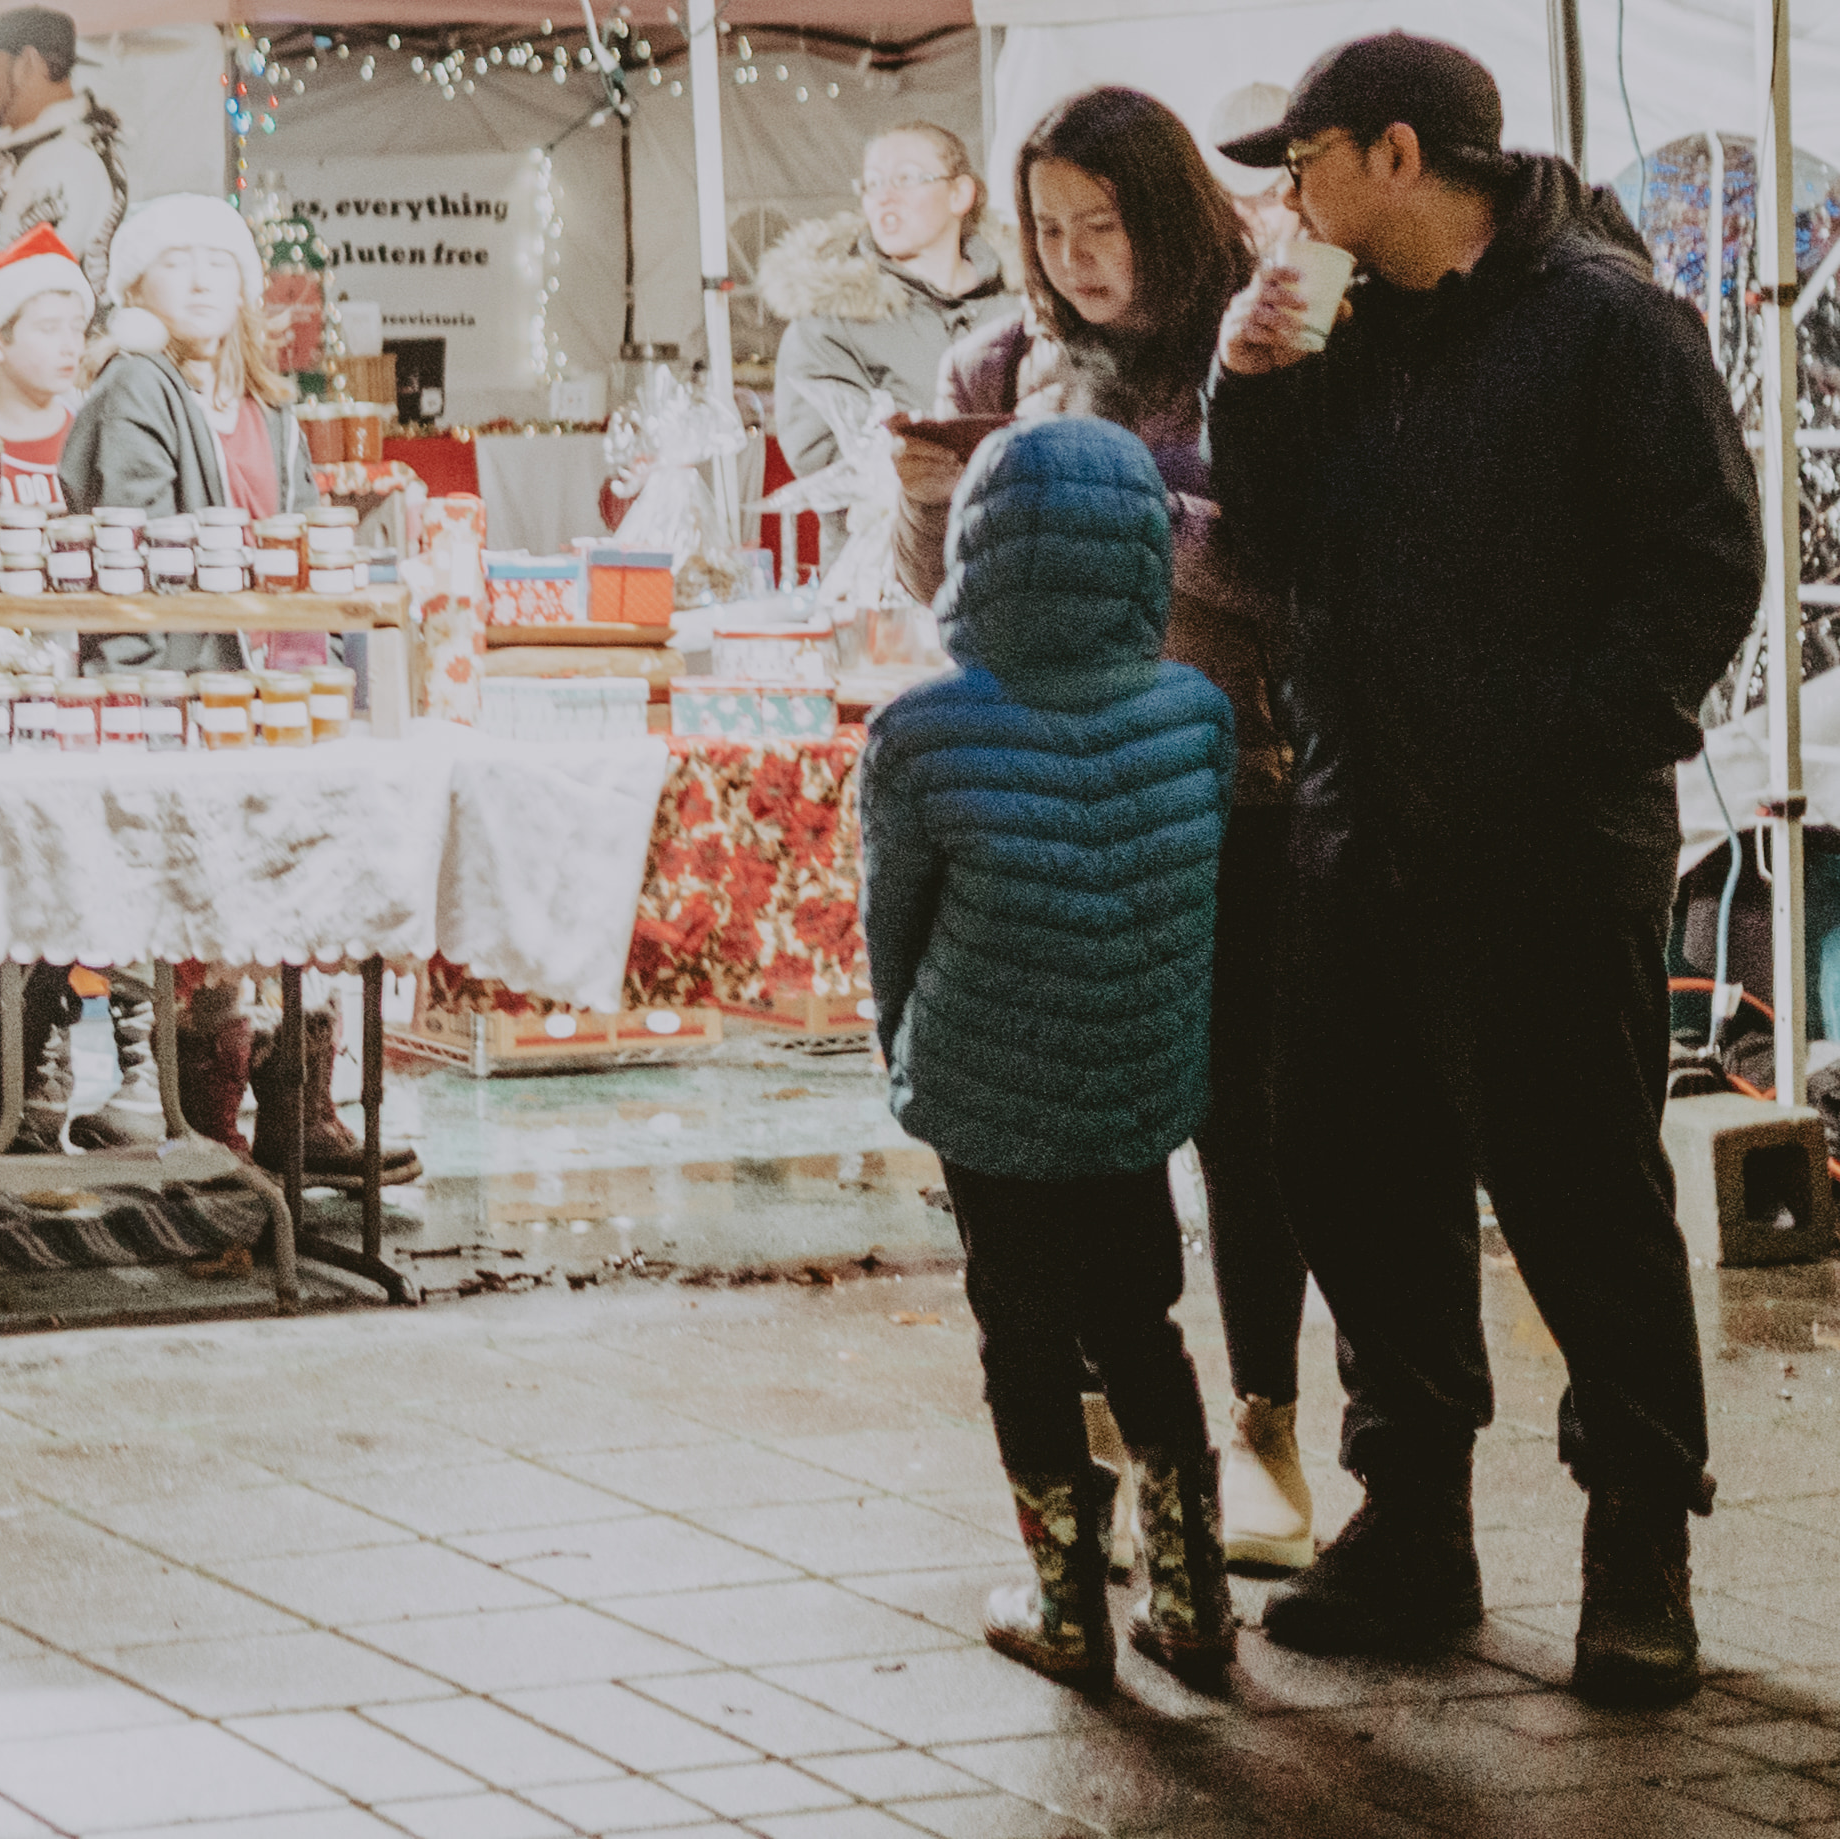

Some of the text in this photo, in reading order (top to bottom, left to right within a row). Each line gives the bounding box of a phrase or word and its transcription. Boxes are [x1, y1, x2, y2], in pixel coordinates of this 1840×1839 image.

[335, 192, 509, 223] everything
[326, 239, 489, 267] gluten free
[382, 310, 476, 328] reevictoria
